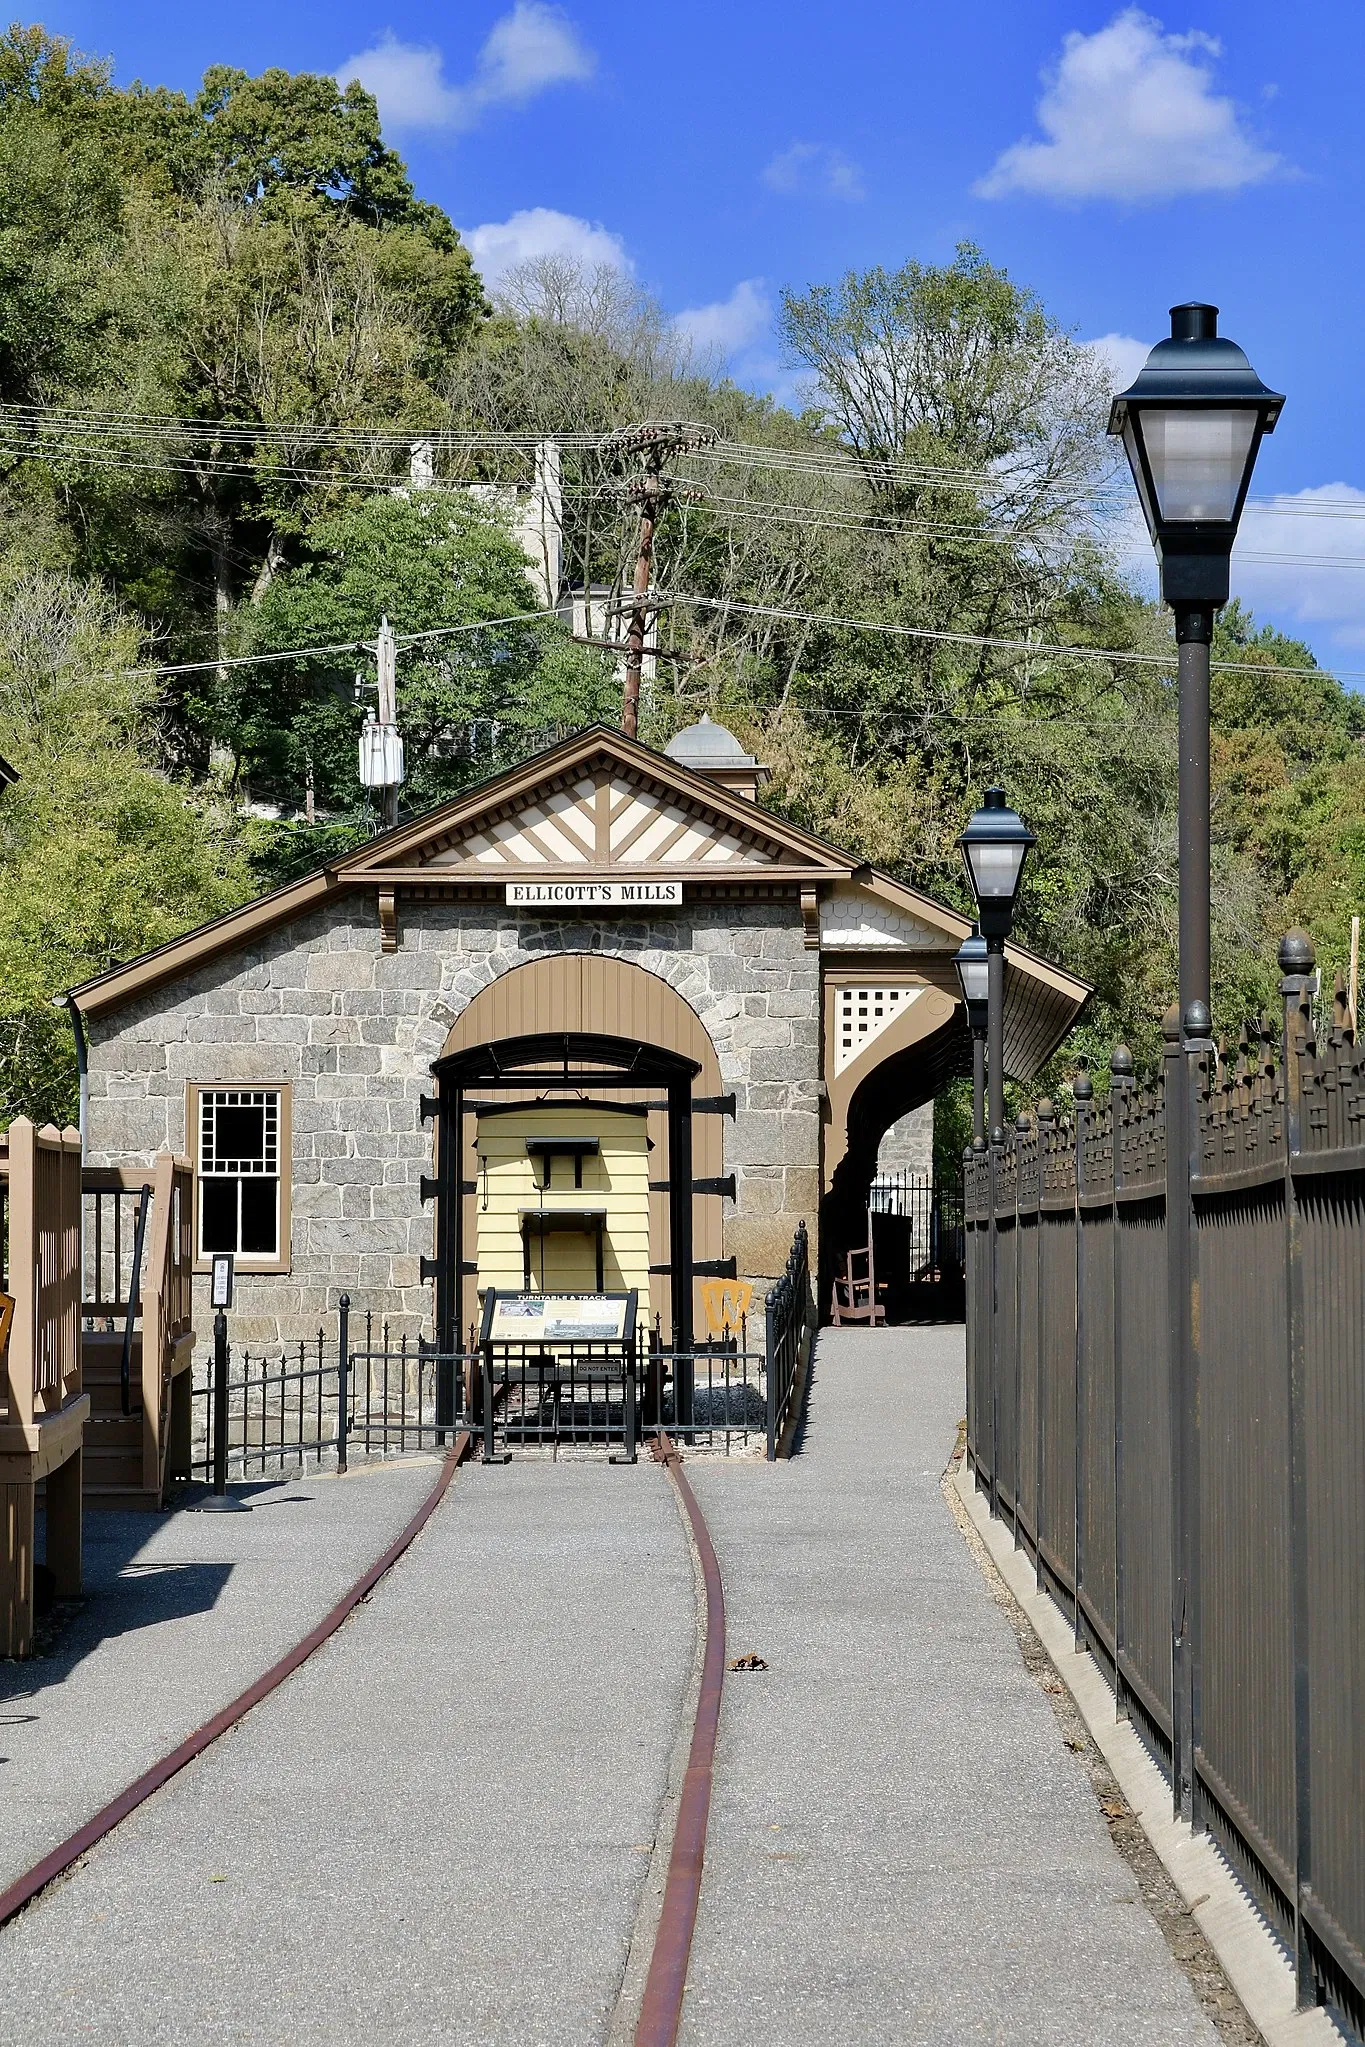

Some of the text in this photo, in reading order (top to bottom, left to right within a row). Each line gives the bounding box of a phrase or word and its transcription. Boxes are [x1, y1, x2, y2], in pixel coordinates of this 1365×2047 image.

[513, 885, 676, 900] ELLICOTT'S MILLS
[707, 1288, 744, 1324] W
